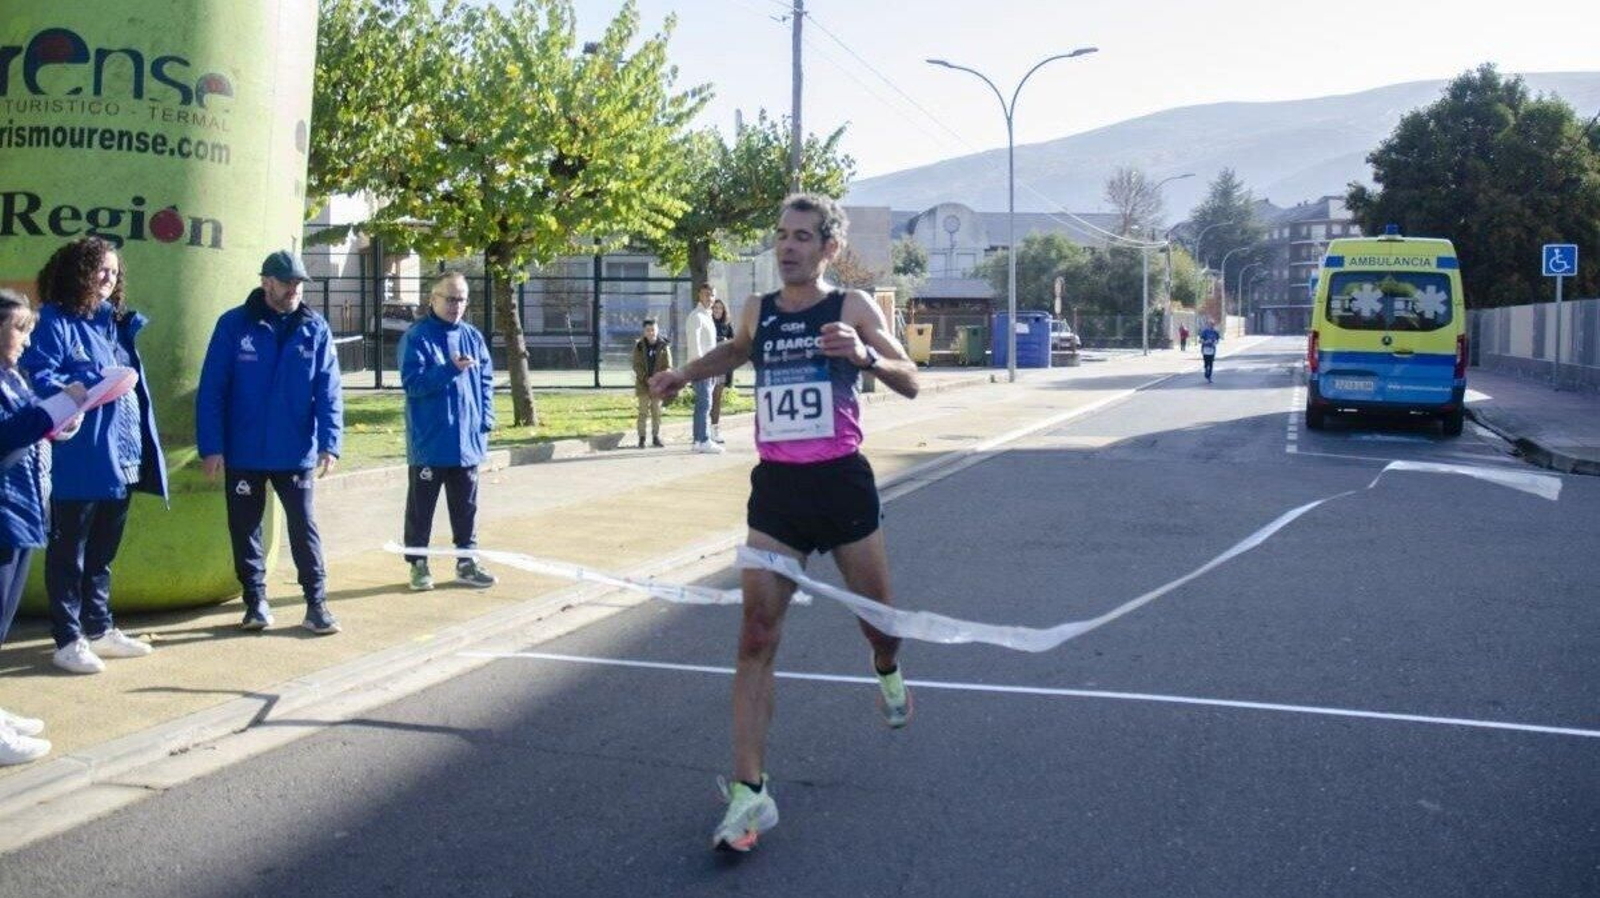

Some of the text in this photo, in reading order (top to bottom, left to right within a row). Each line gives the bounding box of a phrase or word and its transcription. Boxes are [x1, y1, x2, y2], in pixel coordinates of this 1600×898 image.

[148, 105, 231, 132] TERMAL
[1349, 256, 1431, 267] AMBULANCIA
[764, 387, 823, 423] 149
